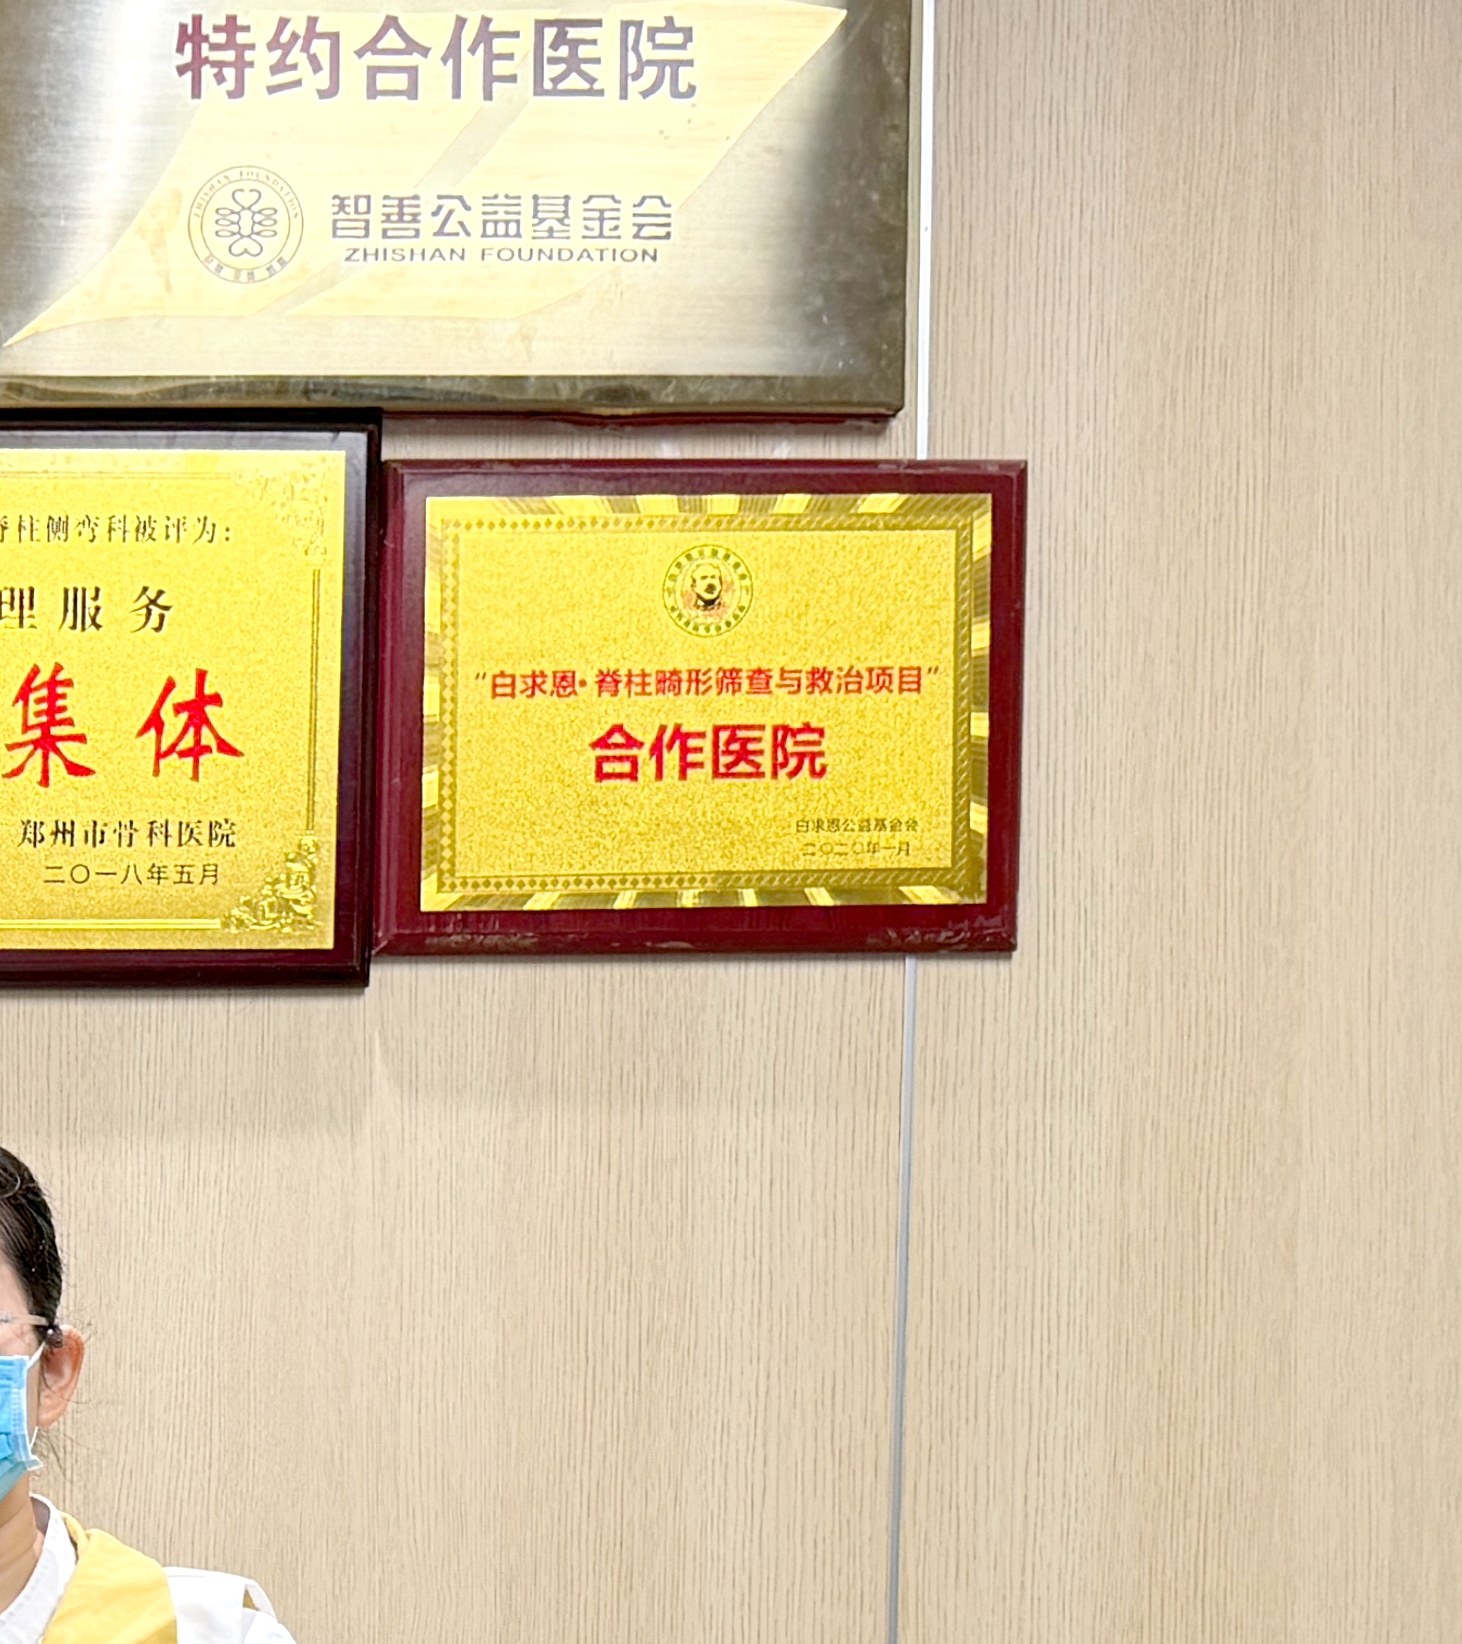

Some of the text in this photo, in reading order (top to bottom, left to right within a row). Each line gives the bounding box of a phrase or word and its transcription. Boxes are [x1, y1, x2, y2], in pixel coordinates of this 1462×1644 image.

[176, 13, 699, 101] 特约合作医院
[331, 192, 675, 242] 智善公益基金会
[343, 245, 659, 263] ZHISHAN FOUNDATION
[588, 722, 828, 784] 合作医院
[18, 817, 237, 850] 郑州市骨科医院
